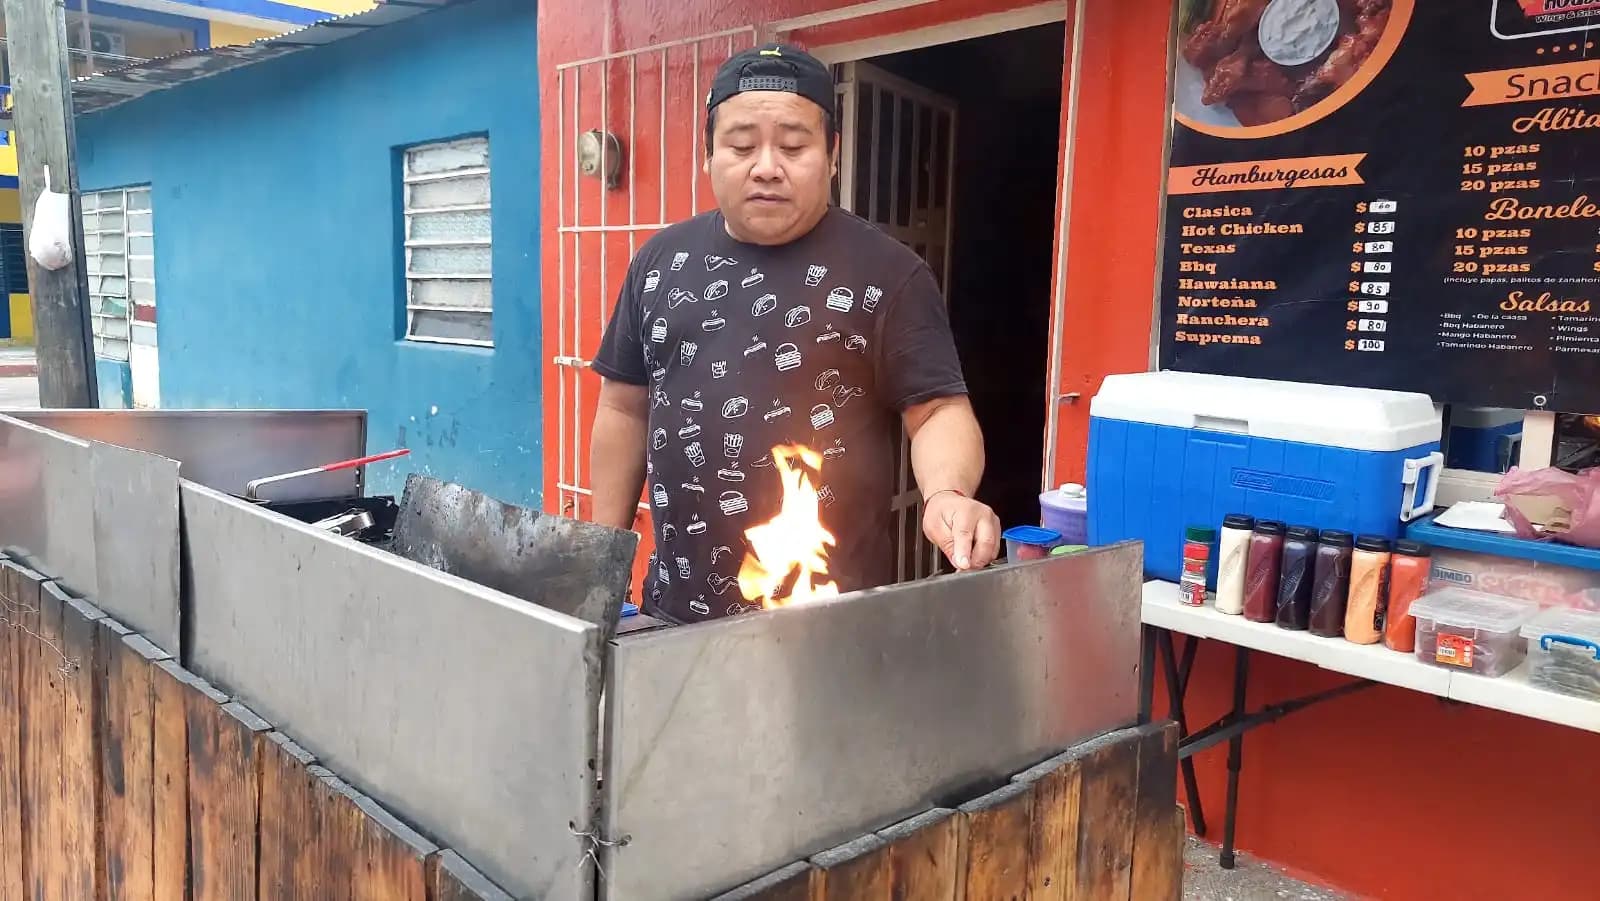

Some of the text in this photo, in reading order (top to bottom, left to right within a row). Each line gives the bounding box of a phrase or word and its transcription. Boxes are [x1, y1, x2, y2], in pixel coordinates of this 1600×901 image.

[1505, 72, 1600, 98] Snac
[1463, 143, 1541, 159] 10 pzas
[1192, 164, 1348, 187] Hamburgesas
[1462, 161, 1537, 176] 15 pzas
[1460, 179, 1541, 193] 20 pzas
[1182, 205, 1253, 219] Clasica
[1355, 201, 1367, 214] $
[1181, 221, 1389, 237] Hot Chicken $ 85
[1455, 227, 1531, 242] 10 pzas
[1180, 243, 1236, 254] Texas
[1352, 241, 1364, 254] $
[1454, 244, 1529, 259] 15 pzas
[1179, 260, 1386, 275] Bbq $ 80
[1453, 261, 1478, 273] 20
[1481, 263, 1531, 276] pzas
[1178, 277, 1382, 294] Hawaiana $ 85
[1177, 295, 1380, 312] Norteña $ 90
[1500, 290, 1590, 312] Salsas
[1176, 313, 1381, 332] Ranchera $ 80
[1462, 322, 1505, 330] Habanero
[1175, 330, 1381, 351] Suprema $ 100
[1441, 331, 1517, 340] Mango Habanero
[1440, 341, 1533, 351] Tamarindo Habanero
